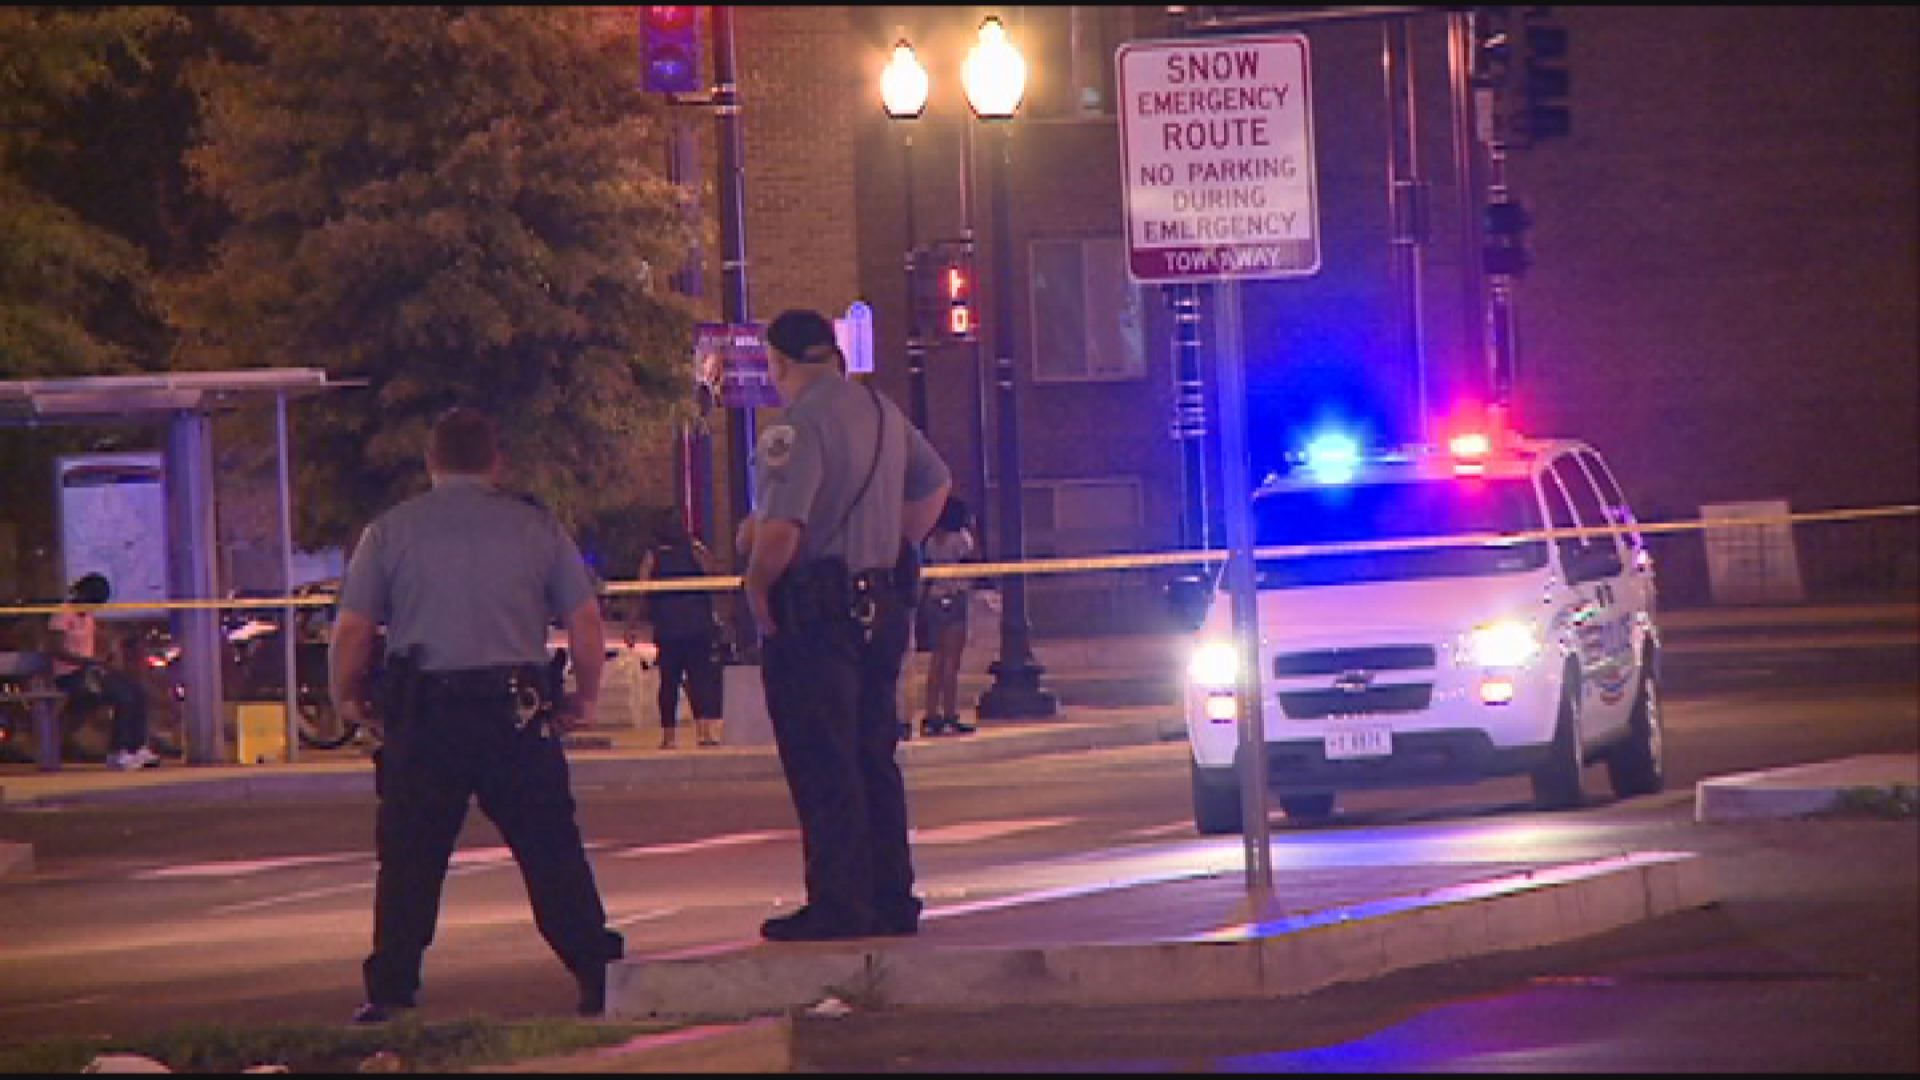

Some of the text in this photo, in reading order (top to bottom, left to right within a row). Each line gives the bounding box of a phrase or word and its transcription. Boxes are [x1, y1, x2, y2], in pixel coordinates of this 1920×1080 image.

[1167, 51, 1259, 83] SNOW
[1138, 84, 1288, 115] EMERGENCY
[1163, 119, 1270, 150] ROUTE
[1141, 156, 1296, 186] NO PARKING
[1173, 186, 1265, 212] DURING
[1144, 212, 1296, 241] EMERGENCY
